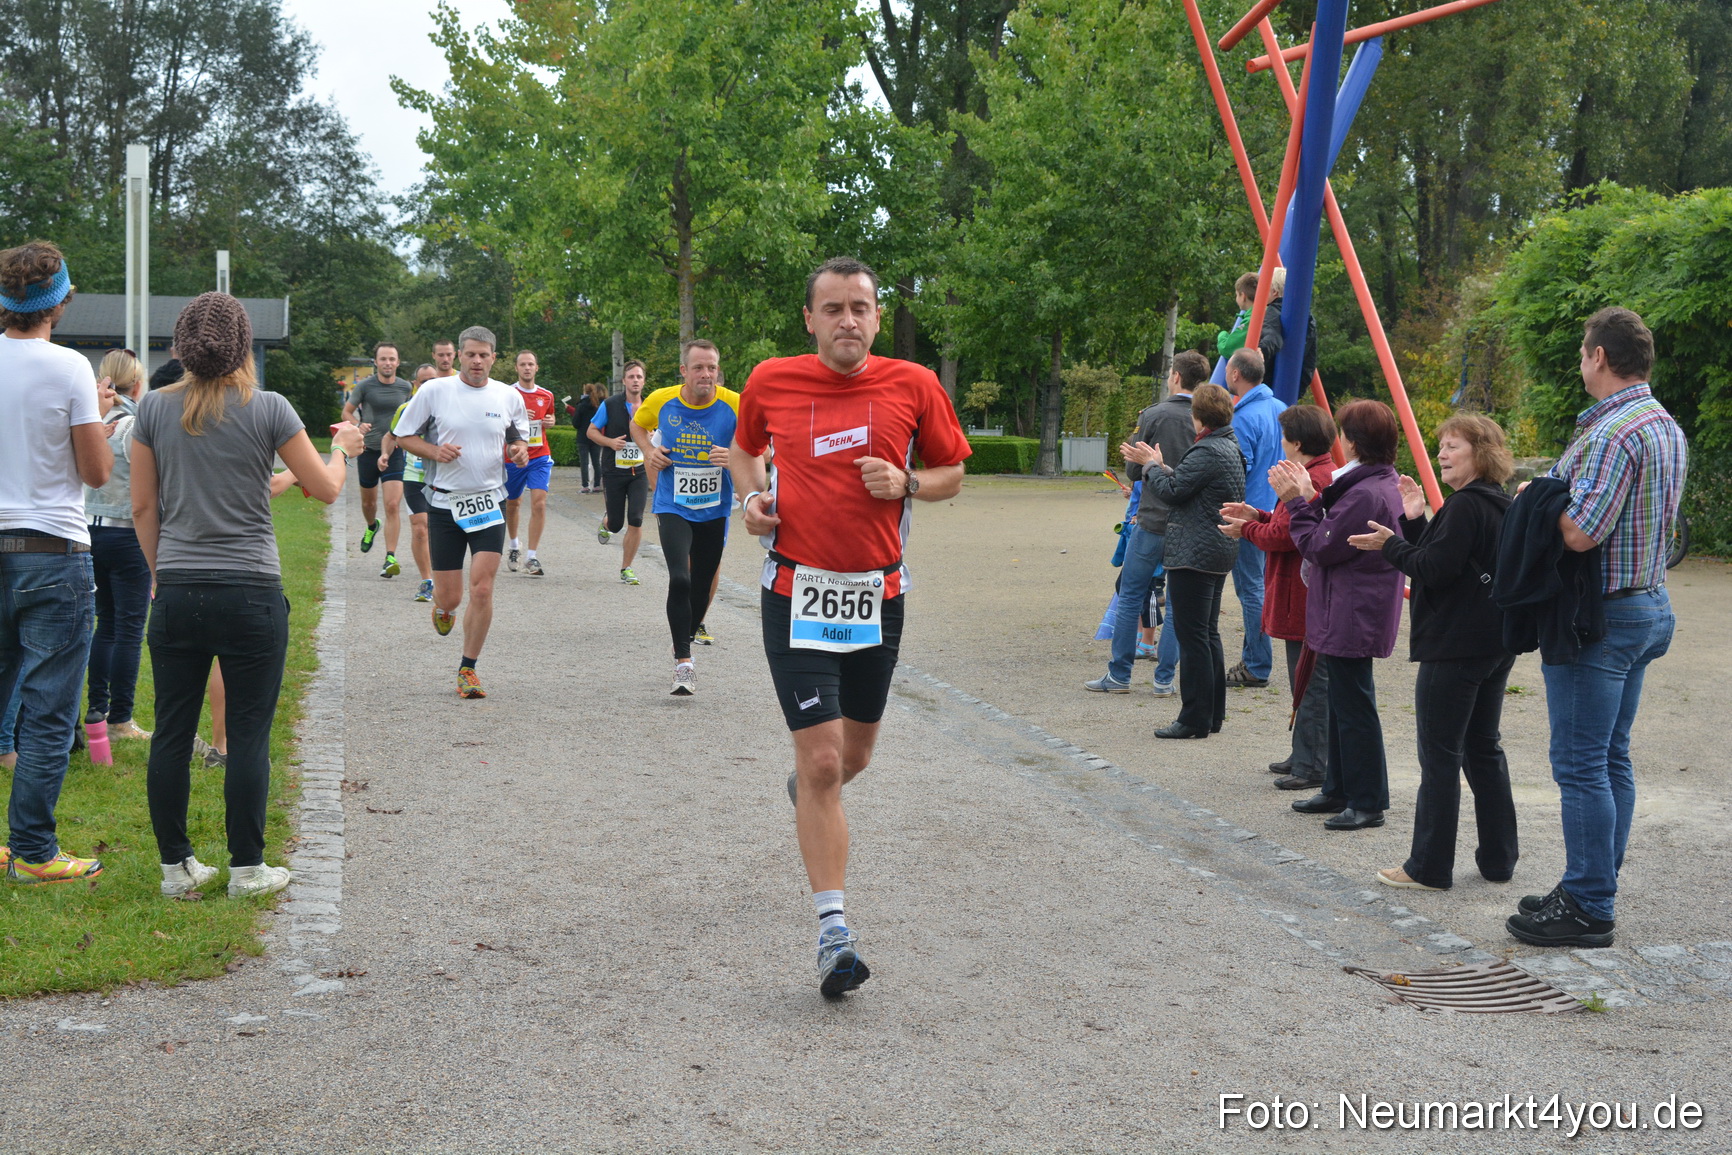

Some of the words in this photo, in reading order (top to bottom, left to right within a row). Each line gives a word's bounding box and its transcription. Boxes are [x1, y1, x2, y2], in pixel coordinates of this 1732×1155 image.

[529, 426, 538, 436] 17
[829, 434, 853, 448] DEHN
[622, 448, 639, 459] 338
[679, 477, 718, 494] 2865
[456, 494, 494, 518] 2566
[469, 515, 490, 526] Roland
[796, 573, 825, 584] PARTL
[827, 577, 870, 587] Neumarkt
[802, 586, 874, 620] 2656
[821, 627, 852, 641] Adolf
